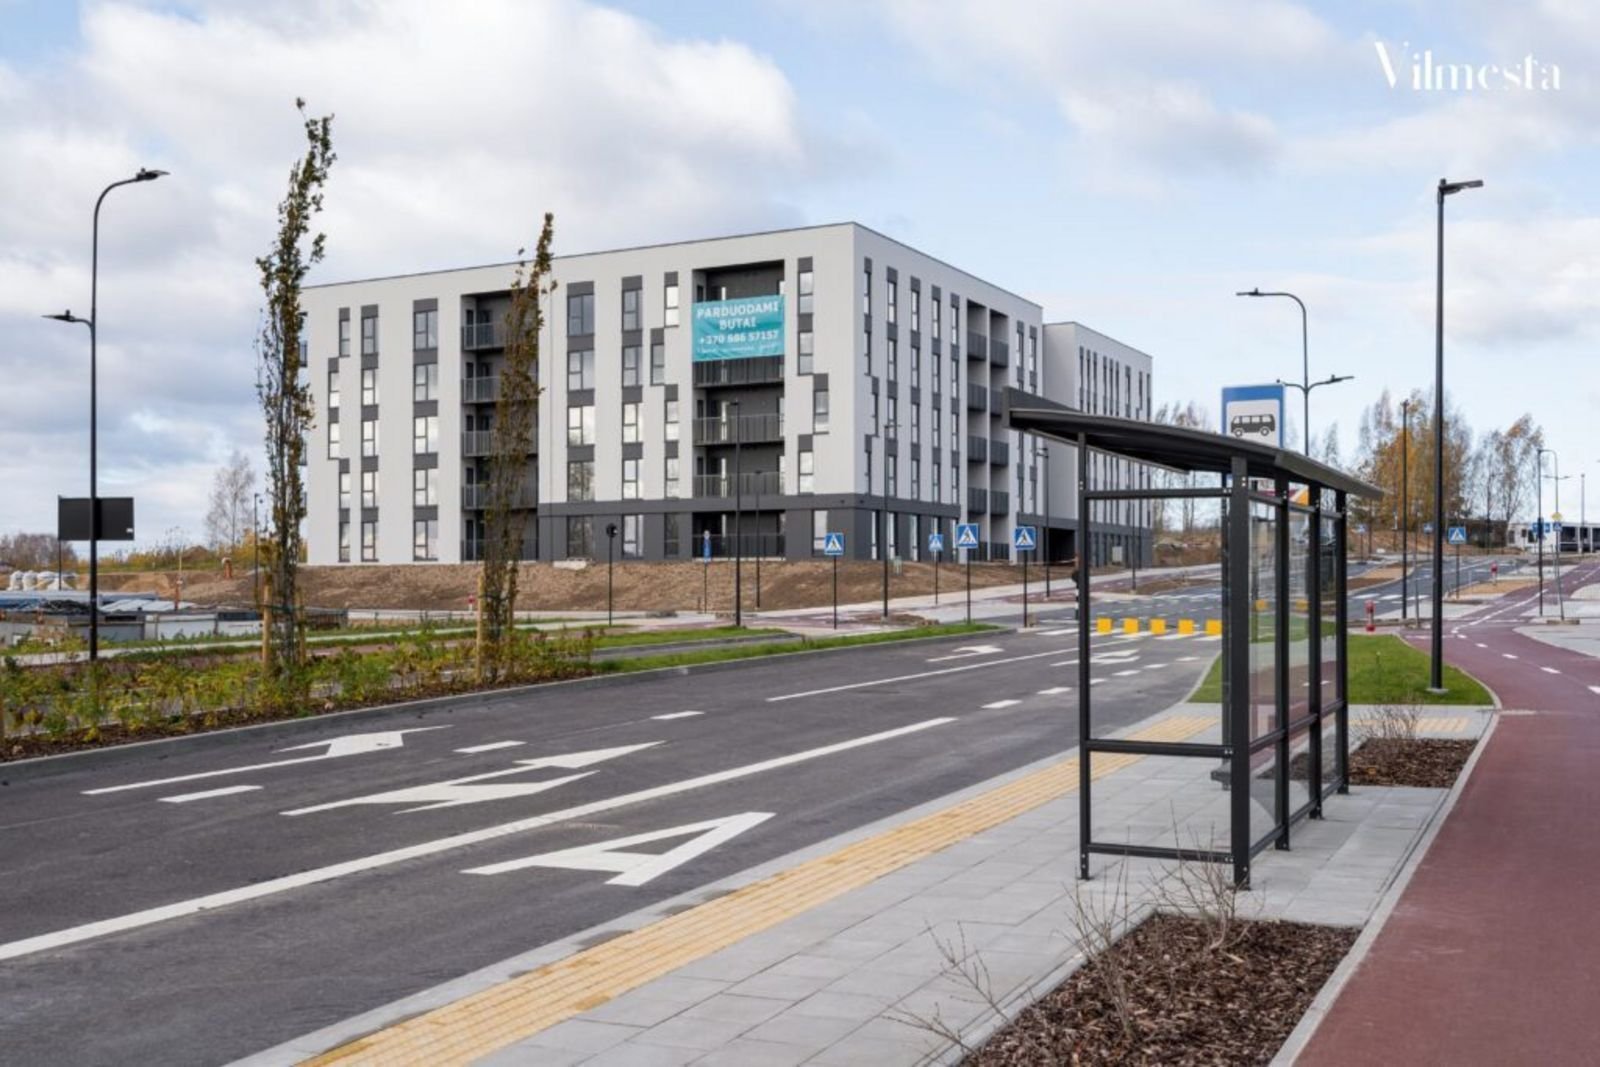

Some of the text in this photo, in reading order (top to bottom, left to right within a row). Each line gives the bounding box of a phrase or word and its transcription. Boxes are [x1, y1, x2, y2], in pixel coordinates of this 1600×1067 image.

[696, 301, 779, 319] PARDUODAMI
[719, 317, 757, 330] BUTAI
[699, 334, 725, 345] +370
[459, 812, 777, 887] A
